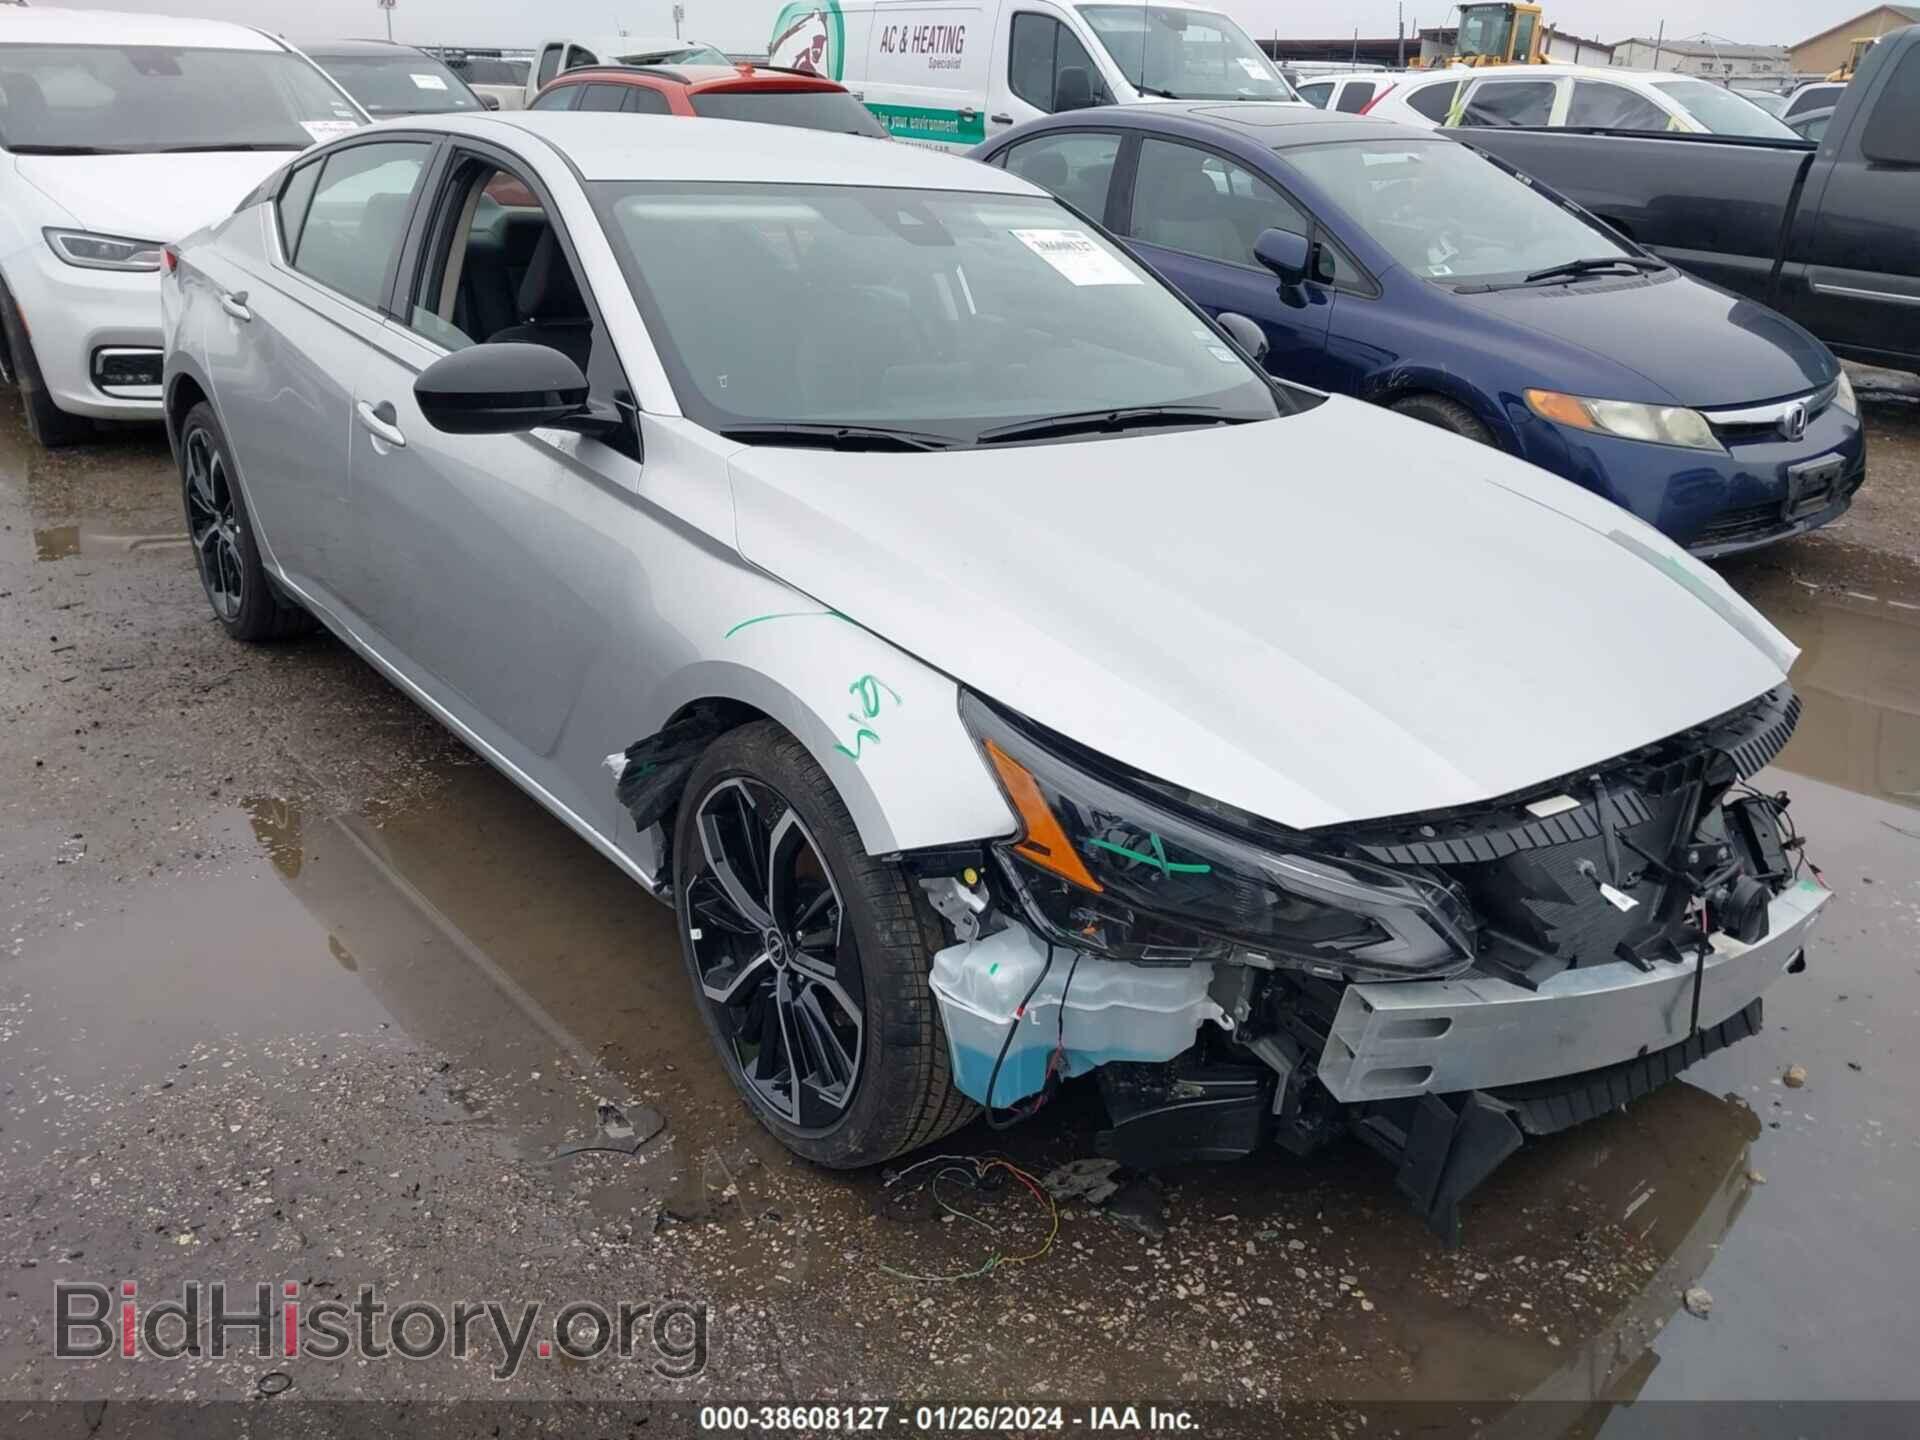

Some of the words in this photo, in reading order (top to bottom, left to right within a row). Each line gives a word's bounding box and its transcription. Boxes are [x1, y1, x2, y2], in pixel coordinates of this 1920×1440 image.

[880, 25, 898, 53] AC
[899, 25, 908, 53] &
[912, 25, 965, 54] HEATING
[910, 115, 959, 134] environment
